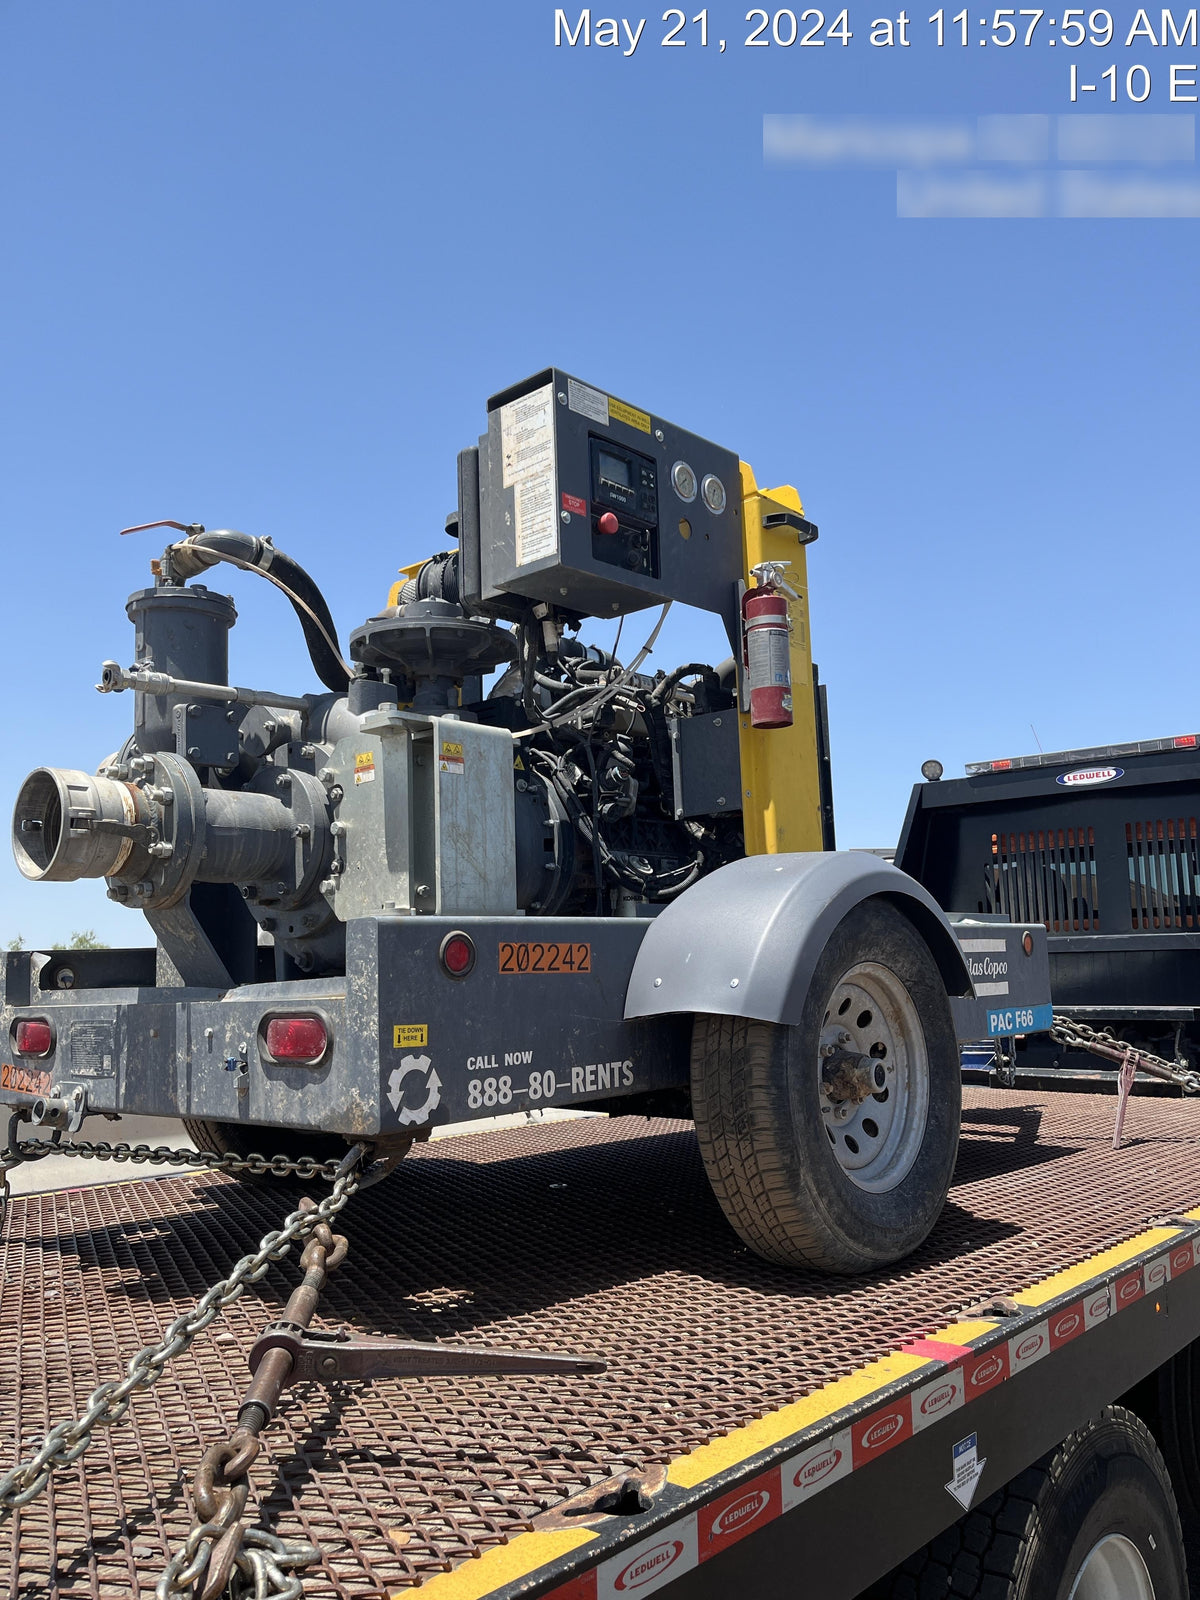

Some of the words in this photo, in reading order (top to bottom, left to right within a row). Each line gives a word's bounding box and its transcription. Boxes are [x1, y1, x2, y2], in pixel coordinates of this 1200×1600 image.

[568, 499, 580, 507] STOP
[1067, 770, 1113, 782] LEDWELL
[501, 943, 590, 972] 202242
[967, 957, 983, 976] las
[983, 956, 1008, 979] Copco
[990, 1012, 1013, 1033] PAC
[1015, 1009, 1034, 1029] F66
[467, 1054, 499, 1071] CALL
[504, 1050, 534, 1067] NOW
[467, 1060, 635, 1109] 888-80-RENTS
[977, 1363, 998, 1379] LEDWELL
[928, 1388, 951, 1408] LEDWELL
[870, 1421, 896, 1441] LEDWELL
[804, 1456, 834, 1479] LEDWELL
[725, 1497, 760, 1526] LEDWELL
[629, 1550, 671, 1581] LEDWELL
